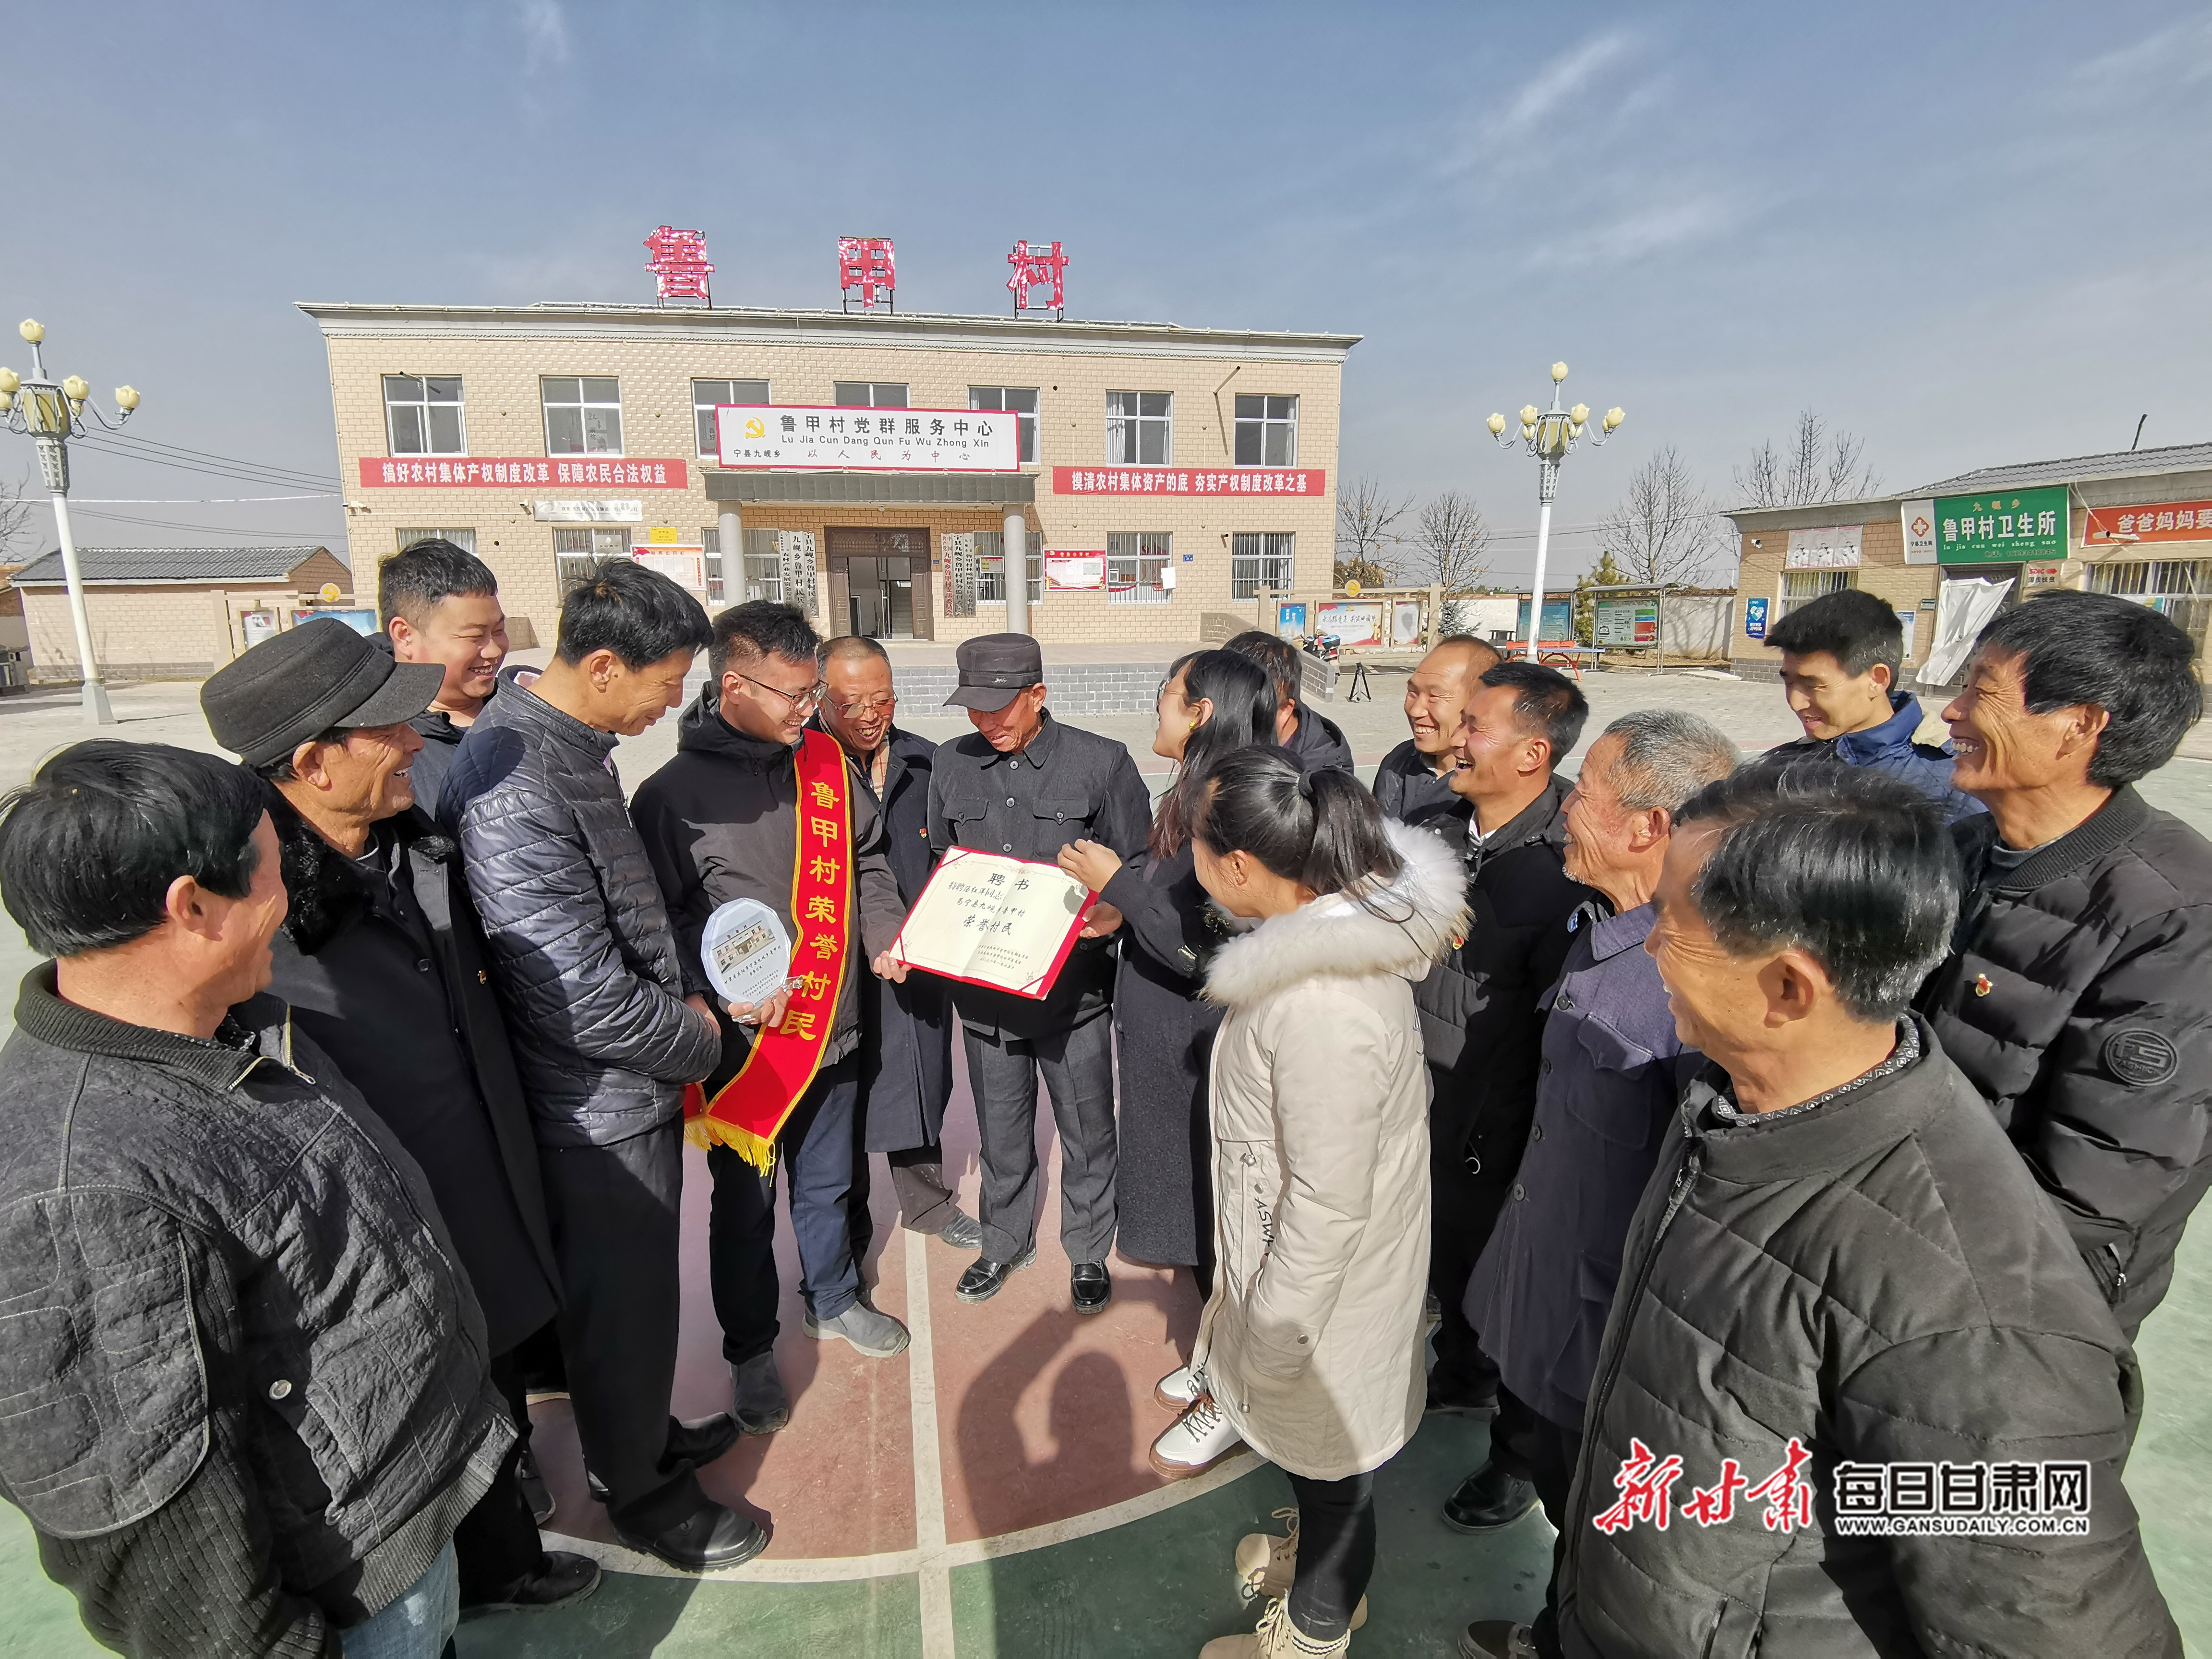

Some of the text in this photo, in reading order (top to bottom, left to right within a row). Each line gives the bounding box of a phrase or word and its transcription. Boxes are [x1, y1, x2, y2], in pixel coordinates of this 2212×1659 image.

[643, 226, 1070, 311] 鲁甲村
[780, 414, 993, 436] 鲁甲村党群服务中心
[799, 435, 814, 444] Jia
[819, 436, 838, 444] Cun
[843, 436, 868, 446] Dang
[874, 436, 893, 445] Qun
[915, 437, 931, 446] Wu
[937, 438, 967, 448] Zhong
[974, 439, 989, 447] Xin
[807, 449, 970, 463] 以人民为中心
[383, 462, 667, 484] 搞好农村集体产权制度改革 保障农民合法权益
[1071, 470, 1307, 493] 摸清农村集体资产的底 夯实产权制度改革之基
[1943, 510, 2056, 542] 鲁甲村卫生所
[2117, 508, 2212, 533] 爸爸妈妈要
[987, 873, 1029, 891] 聘书
[779, 781, 840, 1042] 鲁甲村荣誉村民
[963, 914, 1012, 936] 荣誉村民
